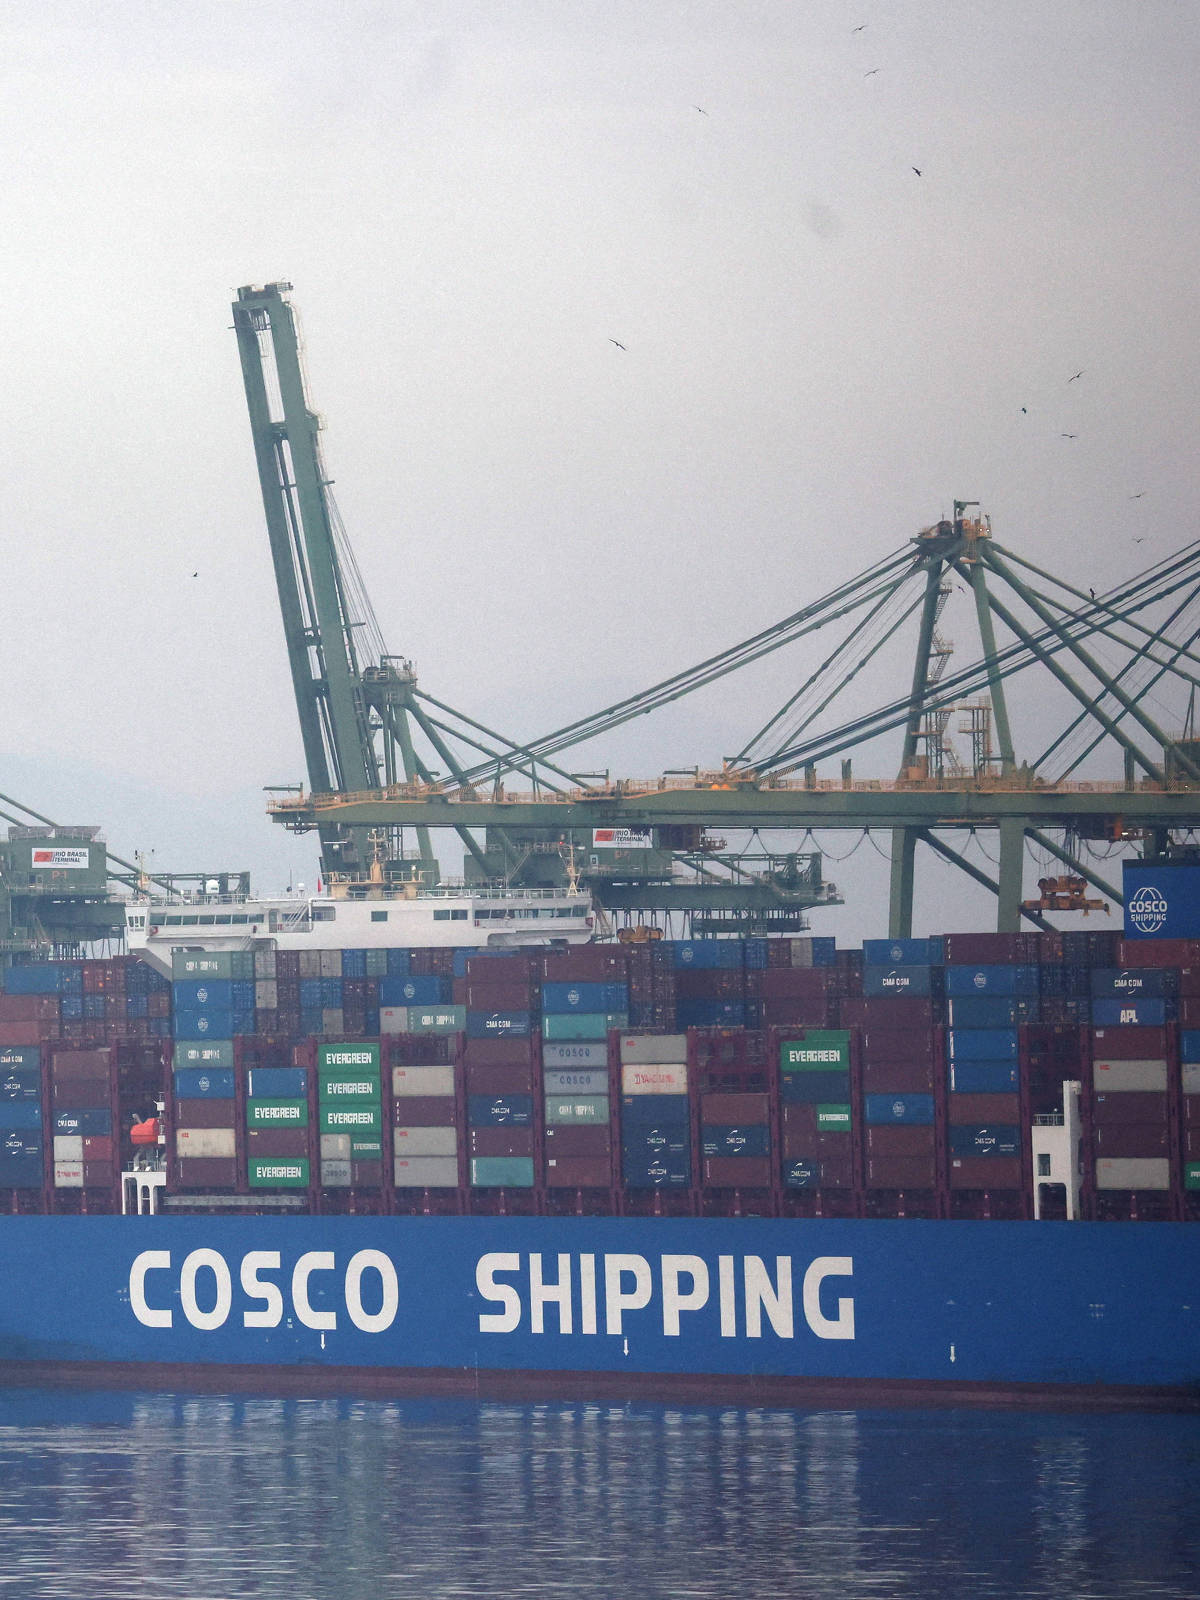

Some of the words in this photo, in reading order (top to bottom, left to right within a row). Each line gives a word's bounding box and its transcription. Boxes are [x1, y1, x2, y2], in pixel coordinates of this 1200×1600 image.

[1129, 901, 1168, 913] COSCO
[1130, 913, 1167, 922] SHIPPING
[1114, 980, 1127, 988] CMA
[1120, 1009, 1138, 1023] APL
[326, 1052, 372, 1064] EVERGREEN
[559, 1048, 590, 1057] COSCO
[789, 1050, 840, 1062] EVERGREEN
[560, 1075, 591, 1084] COSCO
[327, 1082, 372, 1094] EVERGREEN
[254, 1107, 300, 1118] EVERGREEN
[328, 1113, 374, 1124] EVERGREEN
[256, 1166, 301, 1178] EVERGREEN
[130, 1248, 398, 1332] COSCO
[476, 1253, 854, 1339] SHIPPING
